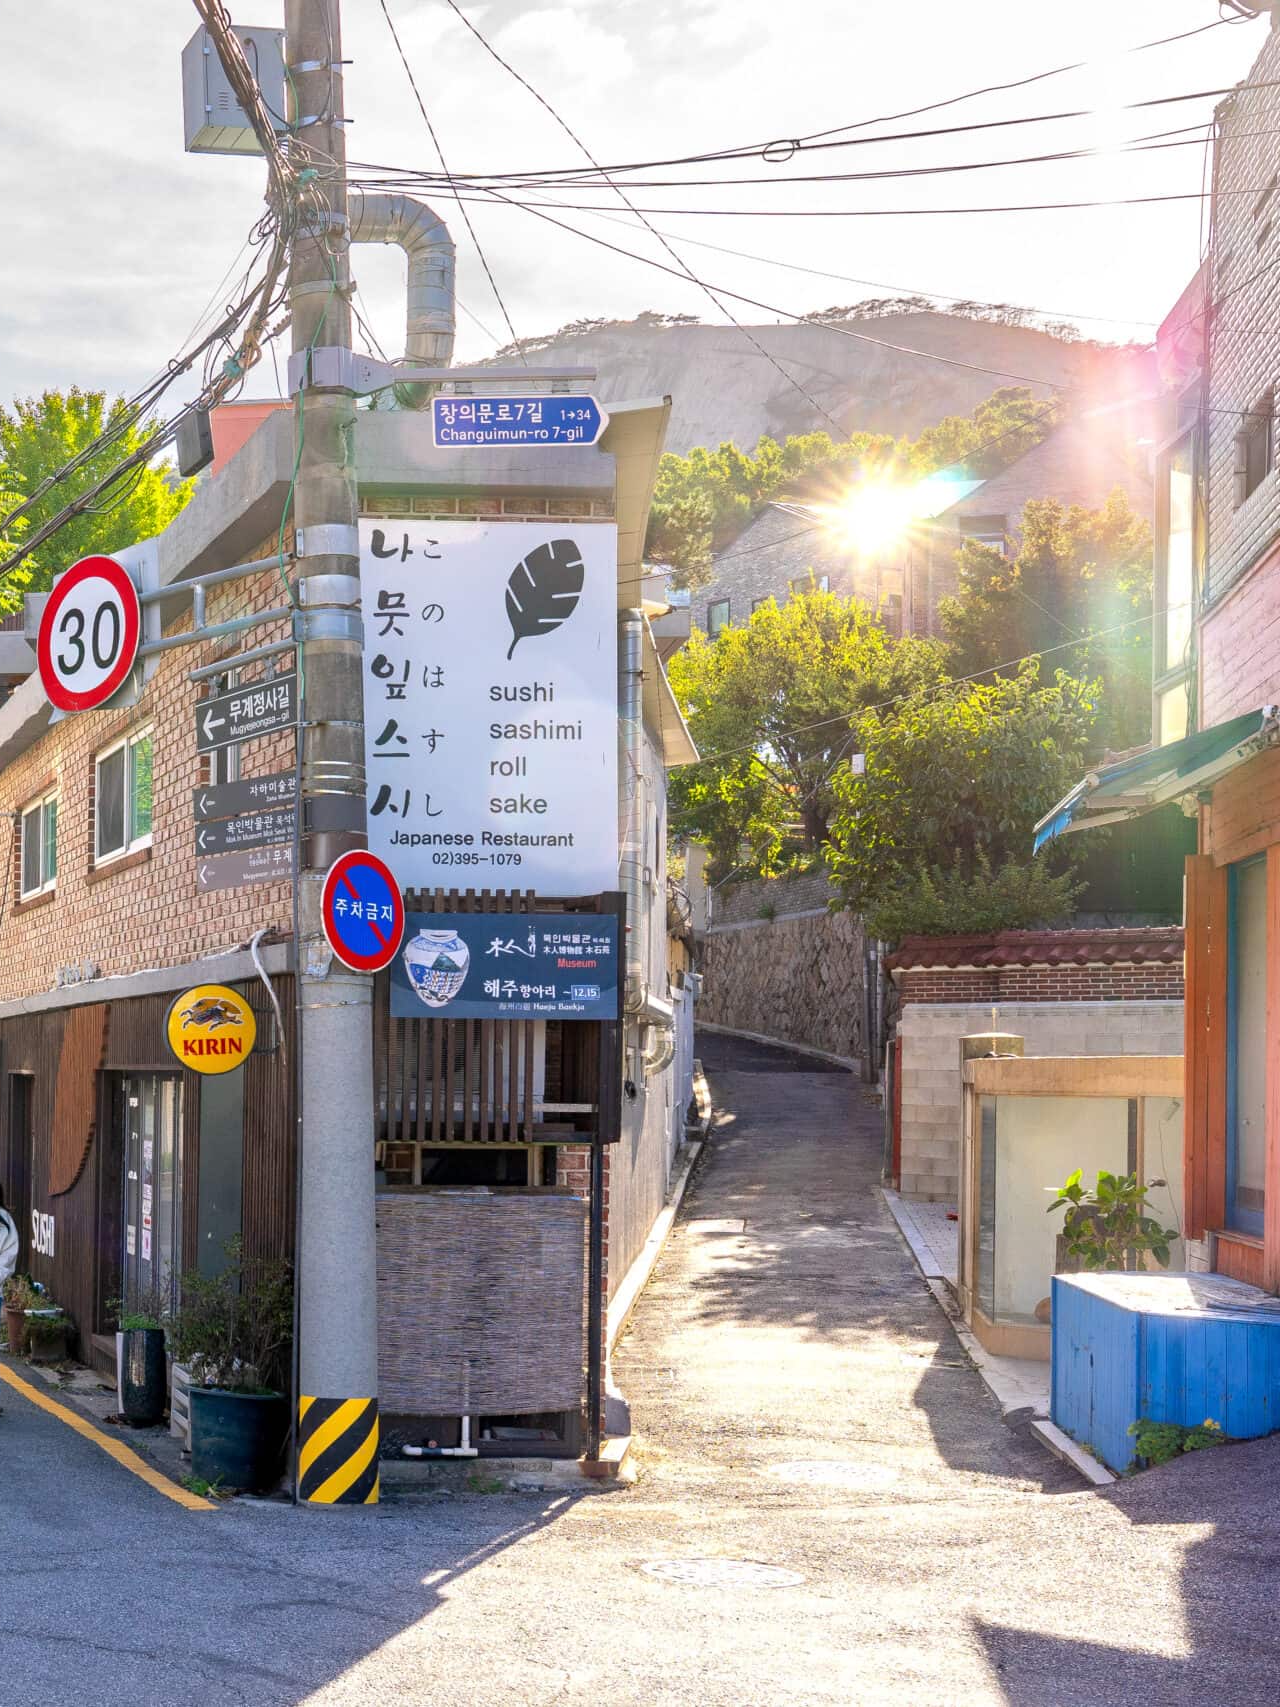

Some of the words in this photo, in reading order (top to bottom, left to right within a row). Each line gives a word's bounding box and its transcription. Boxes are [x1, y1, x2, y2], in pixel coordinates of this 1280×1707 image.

[440, 402, 543, 424] 창의문로7길
[440, 427, 548, 443] Changuimun-ro
[552, 426, 584, 441] 7-gil
[58, 600, 120, 676] 30
[489, 682, 554, 702] sushi
[229, 683, 290, 723] 무계정사길
[489, 719, 582, 741] sashimi
[489, 756, 527, 777] roll
[489, 793, 548, 814] sake
[389, 830, 474, 848] Japanese
[481, 831, 574, 847] Restaurant
[432, 852, 522, 867] 02)395-1079
[335, 897, 393, 923] 주차금지
[557, 958, 597, 968] Museum
[183, 1037, 242, 1056] KIRIN
[31, 1208, 55, 1257] SUSHI
